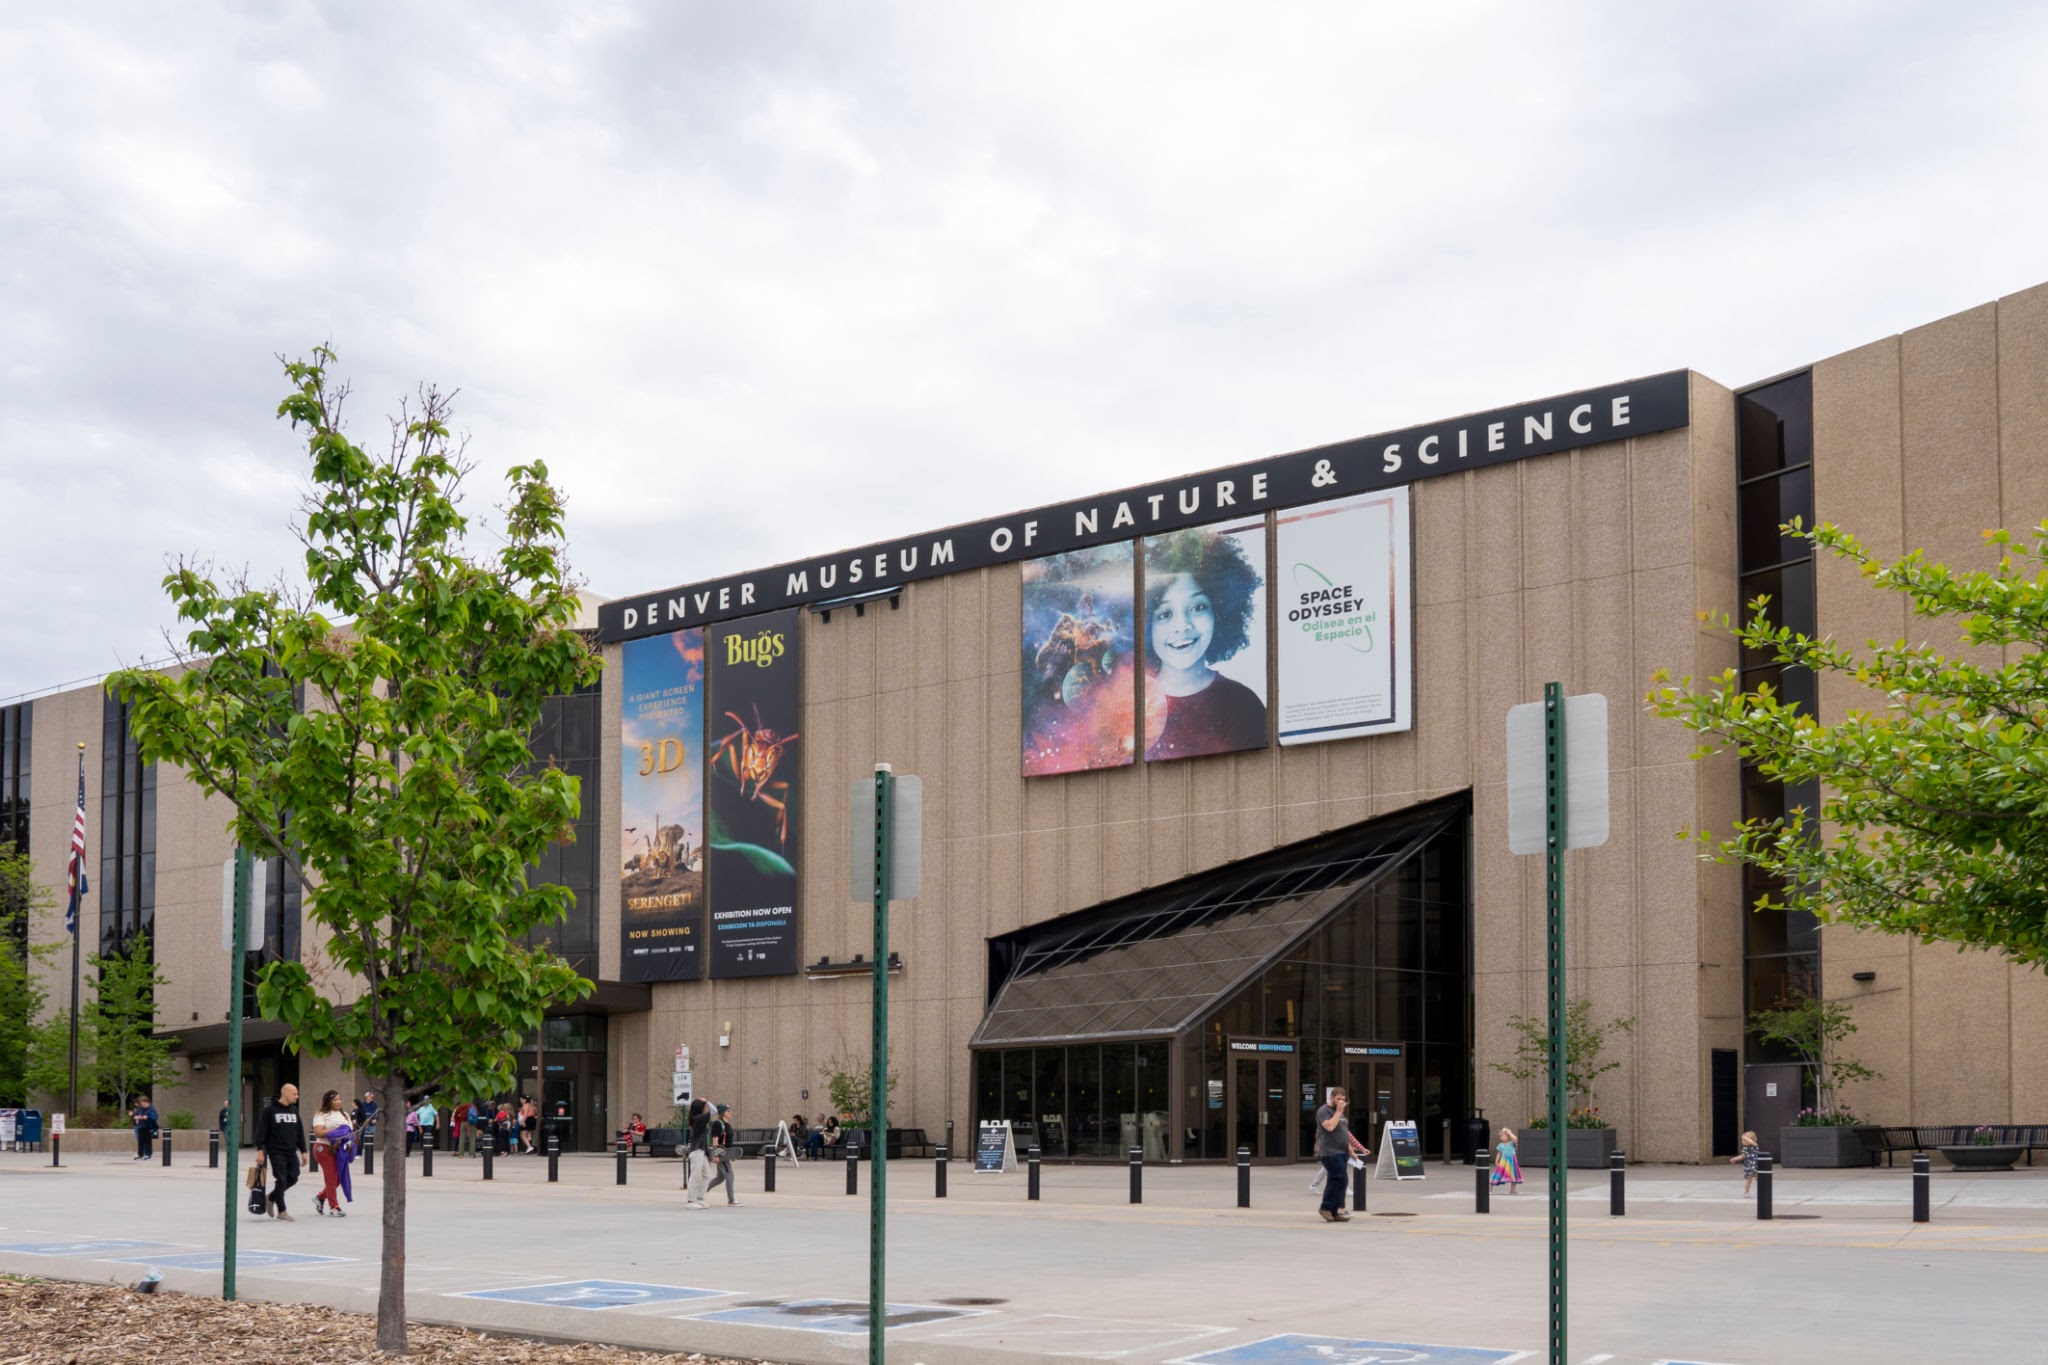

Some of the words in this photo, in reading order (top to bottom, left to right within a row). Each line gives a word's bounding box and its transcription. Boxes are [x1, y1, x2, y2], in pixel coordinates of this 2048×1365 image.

[623, 582, 756, 631] DENVER
[786, 539, 955, 597] MUSEUM
[990, 521, 1038, 553] OF
[1075, 472, 1268, 537] NATURE
[1311, 459, 1338, 488] &
[1383, 395, 1631, 473] SCIENCE
[1300, 585, 1352, 605] SPACE
[1288, 598, 1364, 622] ODYSSEY
[1302, 618, 1344, 632] Odisea
[1347, 615, 1362, 625] en
[1364, 612, 1376, 622] el
[1315, 626, 1362, 641] Espacio
[723, 629, 785, 668] Bugs
[636, 690, 660, 702] GIANT
[662, 683, 695, 697] SCREEN
[638, 696, 688, 712] EXPERIENCE
[639, 738, 684, 776] 3D
[627, 892, 692, 910] SERENGETI
[714, 909, 752, 920] EXHIBITION
[752, 907, 771, 917] NOW
[772, 906, 792, 915] OPEN
[629, 930, 649, 939] NOW
[650, 926, 691, 937] SHOWING
[1231, 1042, 1257, 1050] WELCOME
[1258, 1043, 1293, 1052] BIENVENIDOS
